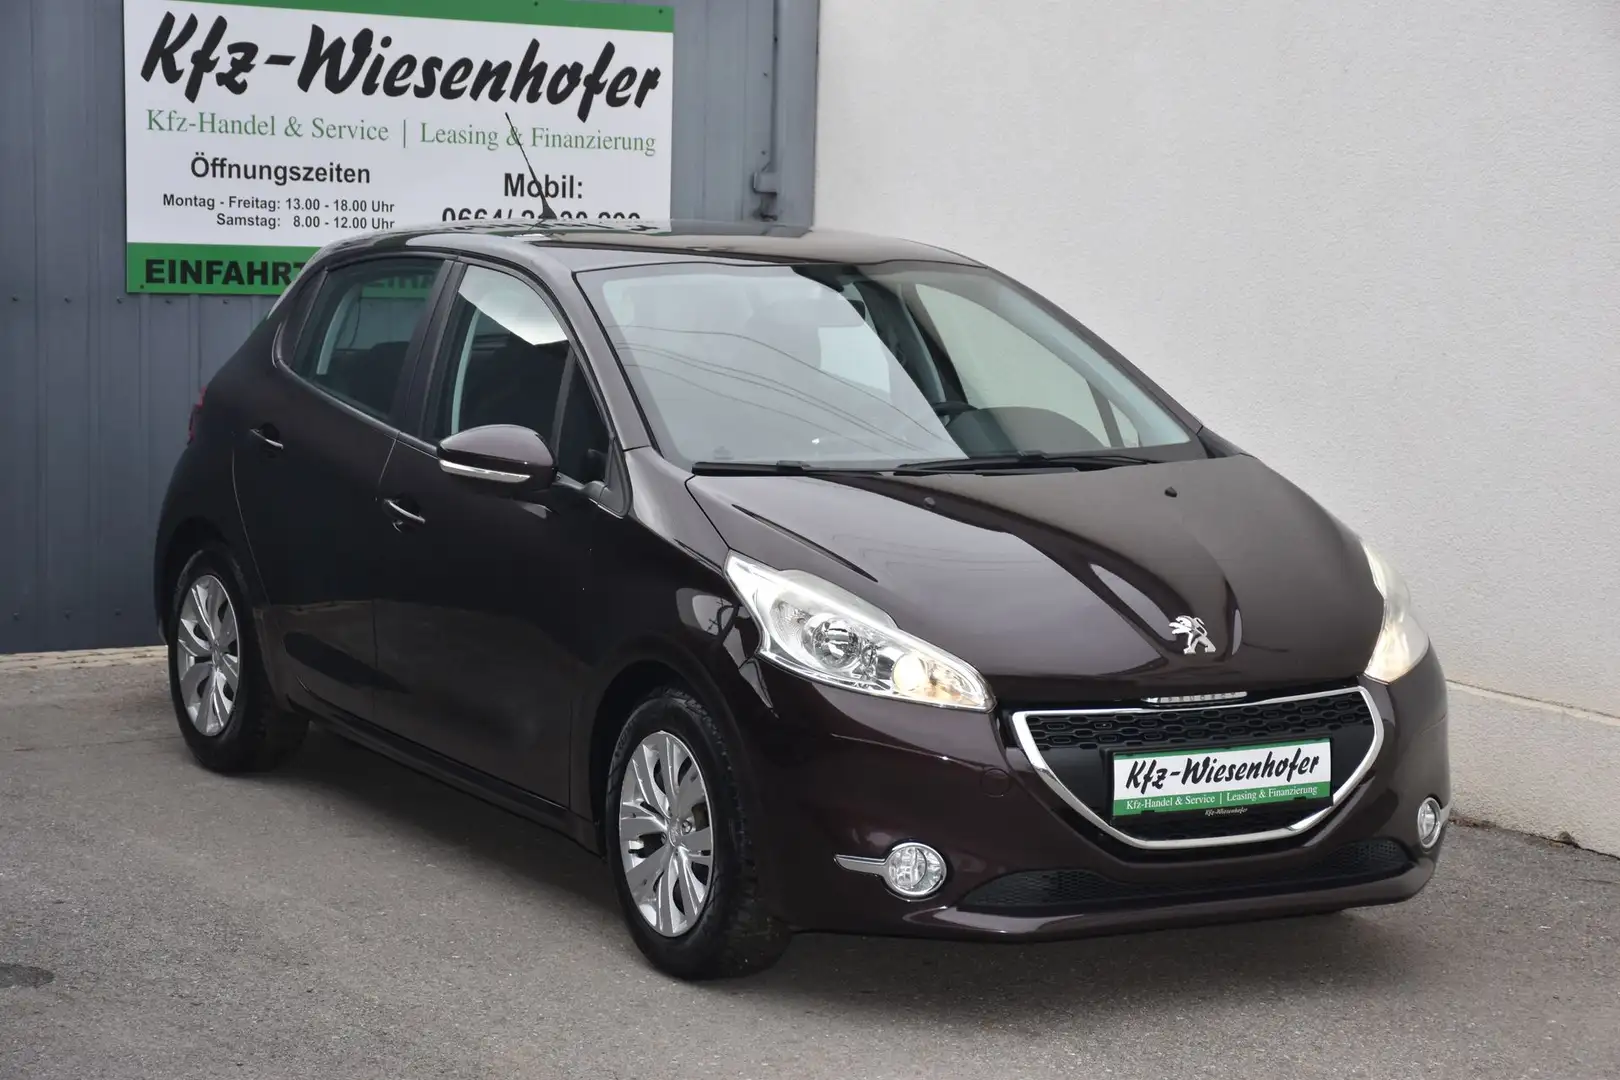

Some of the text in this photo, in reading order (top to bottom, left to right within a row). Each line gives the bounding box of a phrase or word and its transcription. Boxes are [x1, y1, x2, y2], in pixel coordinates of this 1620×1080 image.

[140, 11, 661, 123] Kfz-Wiesenhofer
[147, 109, 656, 156] Kfz-Handel & Service Leasing & Finanzierung
[191, 152, 370, 186] Öffnungszeiten
[503, 173, 583, 199] Mobil:
[163, 194, 215, 210] Montag
[229, 196, 280, 212] Freitag:
[286, 199, 320, 211] 13.00
[334, 200, 367, 212] 18.00
[372, 201, 395, 213] Uhr
[216, 213, 281, 230] Samstag:
[293, 216, 320, 228] 8.00
[334, 217, 367, 229] 12.00
[372, 218, 395, 229] Uhr
[1126, 748, 1320, 794] Kfz-Wiesenhofer
[1126, 785, 1318, 810] Kfz-Handel & Service Leasing & Finanzierung
